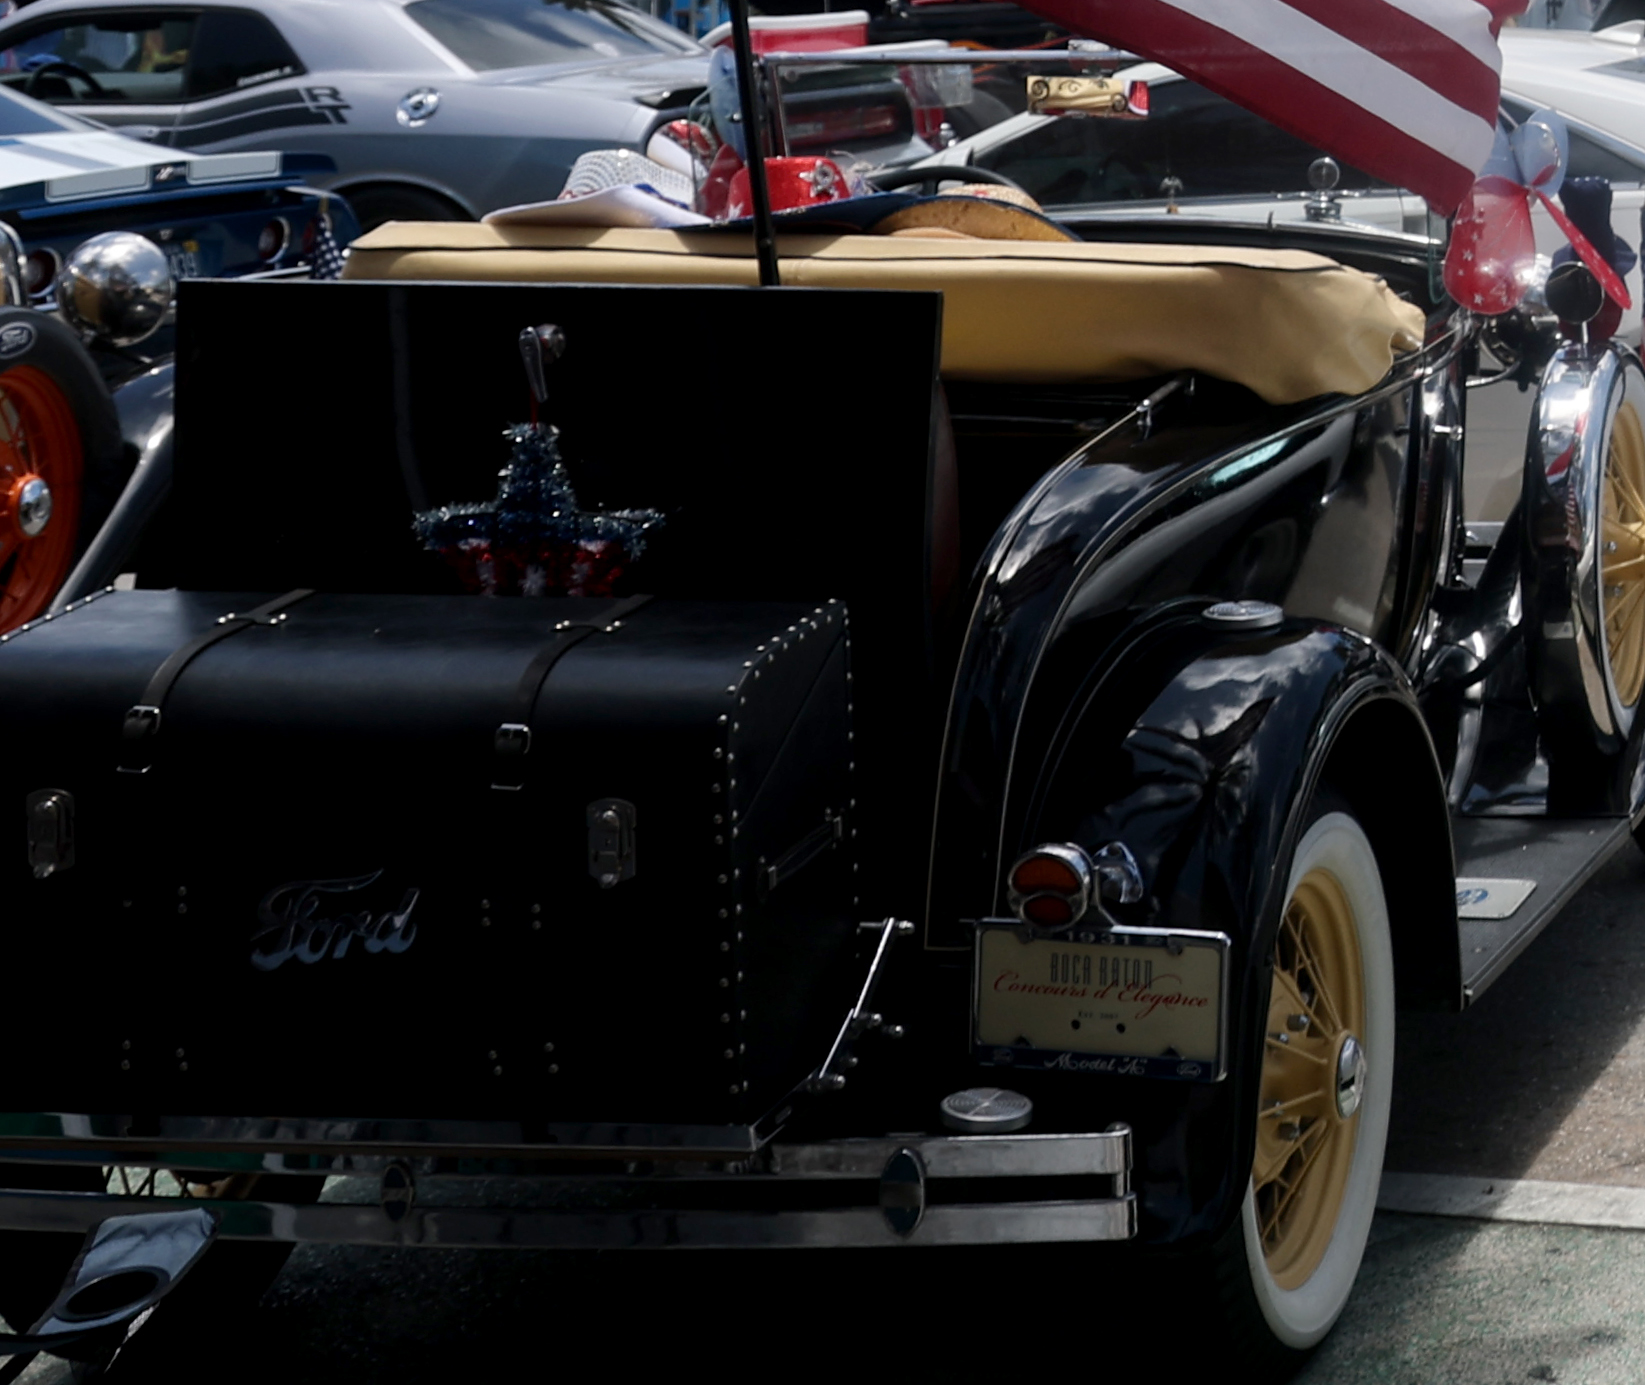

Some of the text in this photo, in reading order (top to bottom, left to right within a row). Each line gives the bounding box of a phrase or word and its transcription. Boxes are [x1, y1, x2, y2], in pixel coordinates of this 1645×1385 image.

[305, 87, 345, 103] R
[312, 105, 352, 124] T
[250, 867, 421, 972] Ford
[1050, 952, 1153, 990] BOCA RATON
[993, 969, 1087, 998] Concours
[1044, 1052, 1117, 1072] Model
